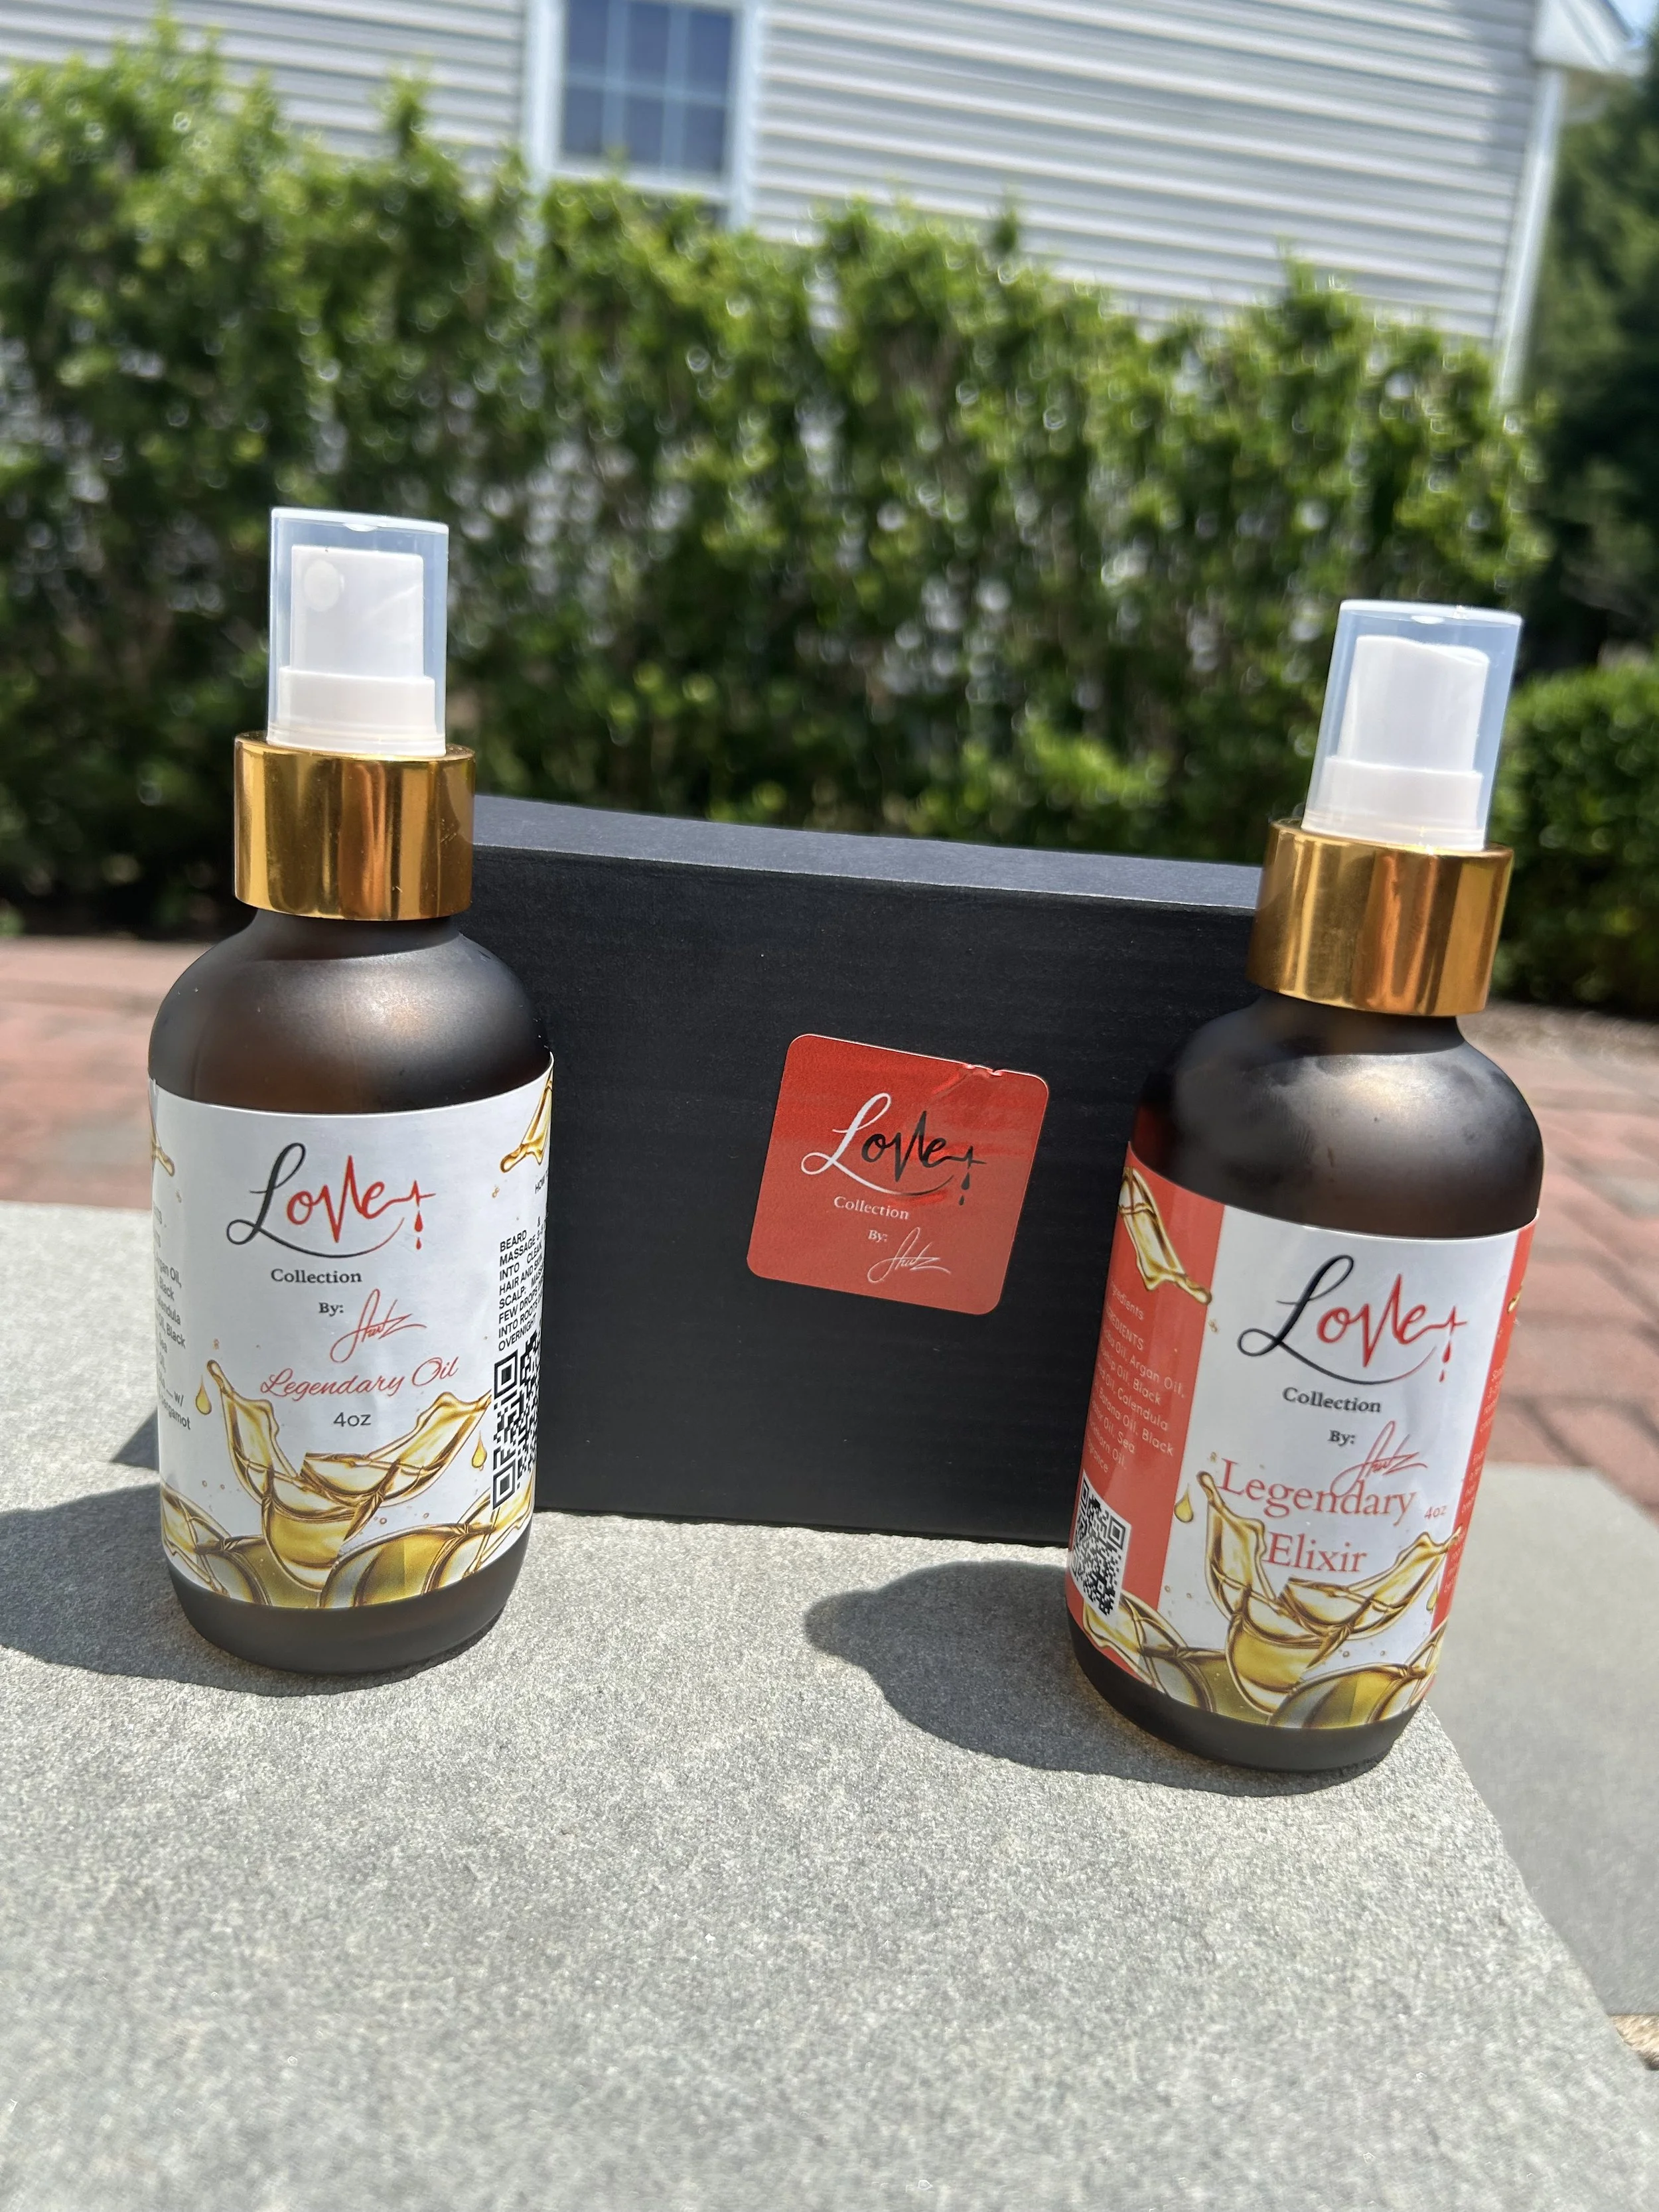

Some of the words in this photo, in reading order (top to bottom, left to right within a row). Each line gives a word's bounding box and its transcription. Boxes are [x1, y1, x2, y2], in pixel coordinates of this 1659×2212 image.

[833, 1195, 909, 1220] Collection
[500, 1230, 527, 1252] BEARD
[868, 1229, 888, 1243] By:
[500, 1234, 536, 1267] MASSAGE
[271, 1268, 362, 1284] Collection
[500, 1262, 520, 1281] INTO
[500, 1276, 519, 1295] HAIR
[520, 1265, 533, 1284] AND
[319, 1302, 344, 1317] By:
[499, 1286, 526, 1309] SCALP:
[499, 1304, 518, 1324] FEW
[520, 1286, 538, 1311] DROPS
[498, 1318, 518, 1338] INTO
[520, 1298, 538, 1325] ROOTS
[498, 1312, 536, 1351] OVERNIGHT
[166, 1322, 186, 1349] Black
[260, 1368, 405, 1401] Legendary
[412, 1357, 459, 1386] Oil
[1129, 1355, 1160, 1382] Argan
[1133, 1377, 1161, 1405] Black
[1282, 1386, 1382, 1413] Collection
[1118, 1387, 1169, 1431] Calendula
[1117, 1431, 1135, 1453] Sea
[1141, 1428, 1173, 1457] Black
[1328, 1430, 1356, 1447] By:
[1217, 1457, 1417, 1526] Legendary
[1262, 1531, 1368, 1572] Elixir
